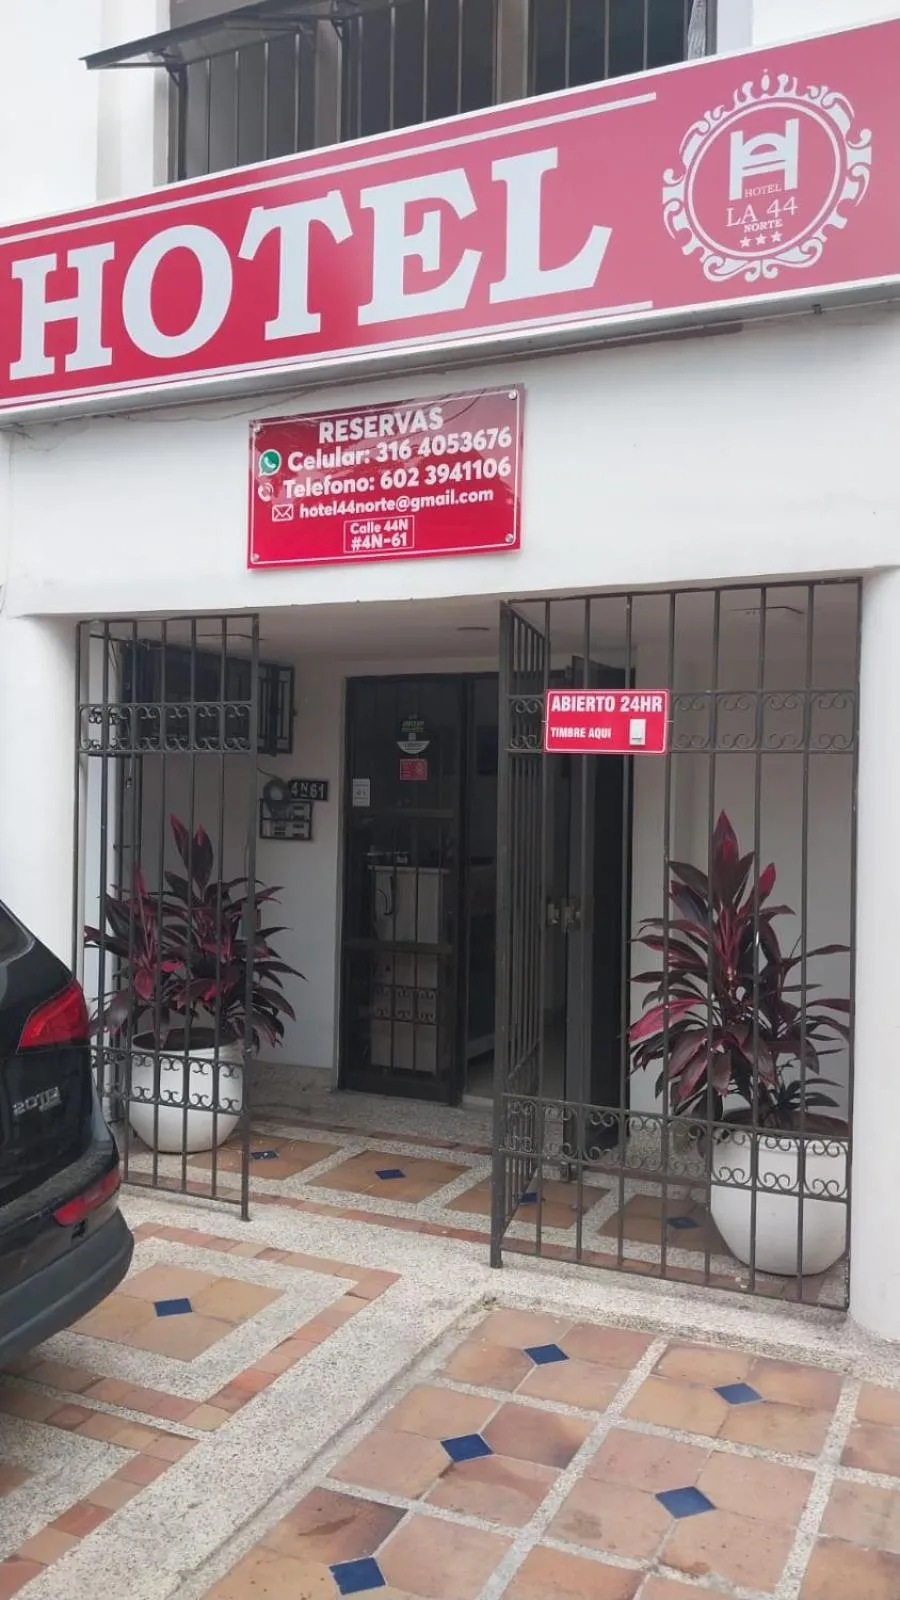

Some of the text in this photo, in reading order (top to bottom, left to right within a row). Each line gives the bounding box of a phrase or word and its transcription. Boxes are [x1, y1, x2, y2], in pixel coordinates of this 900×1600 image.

[744, 184, 782, 198] HOTEL
[726, 196, 799, 227] LA 44
[743, 218, 784, 233] NORTE
[9, 147, 612, 381] HOTEL
[319, 407, 444, 444] RESERVAS
[287, 427, 512, 472] Celular: 316 4053676
[283, 457, 512, 500] Telefono: 602 3941106
[300, 487, 494, 519] hotel44norte@gmail.com
[350, 519, 409, 535] Calle 44N
[351, 532, 408, 551] #4N-61
[551, 695, 663, 712] ABIERTO 24HR
[550, 727, 612, 739] TIMBRE AQUI
